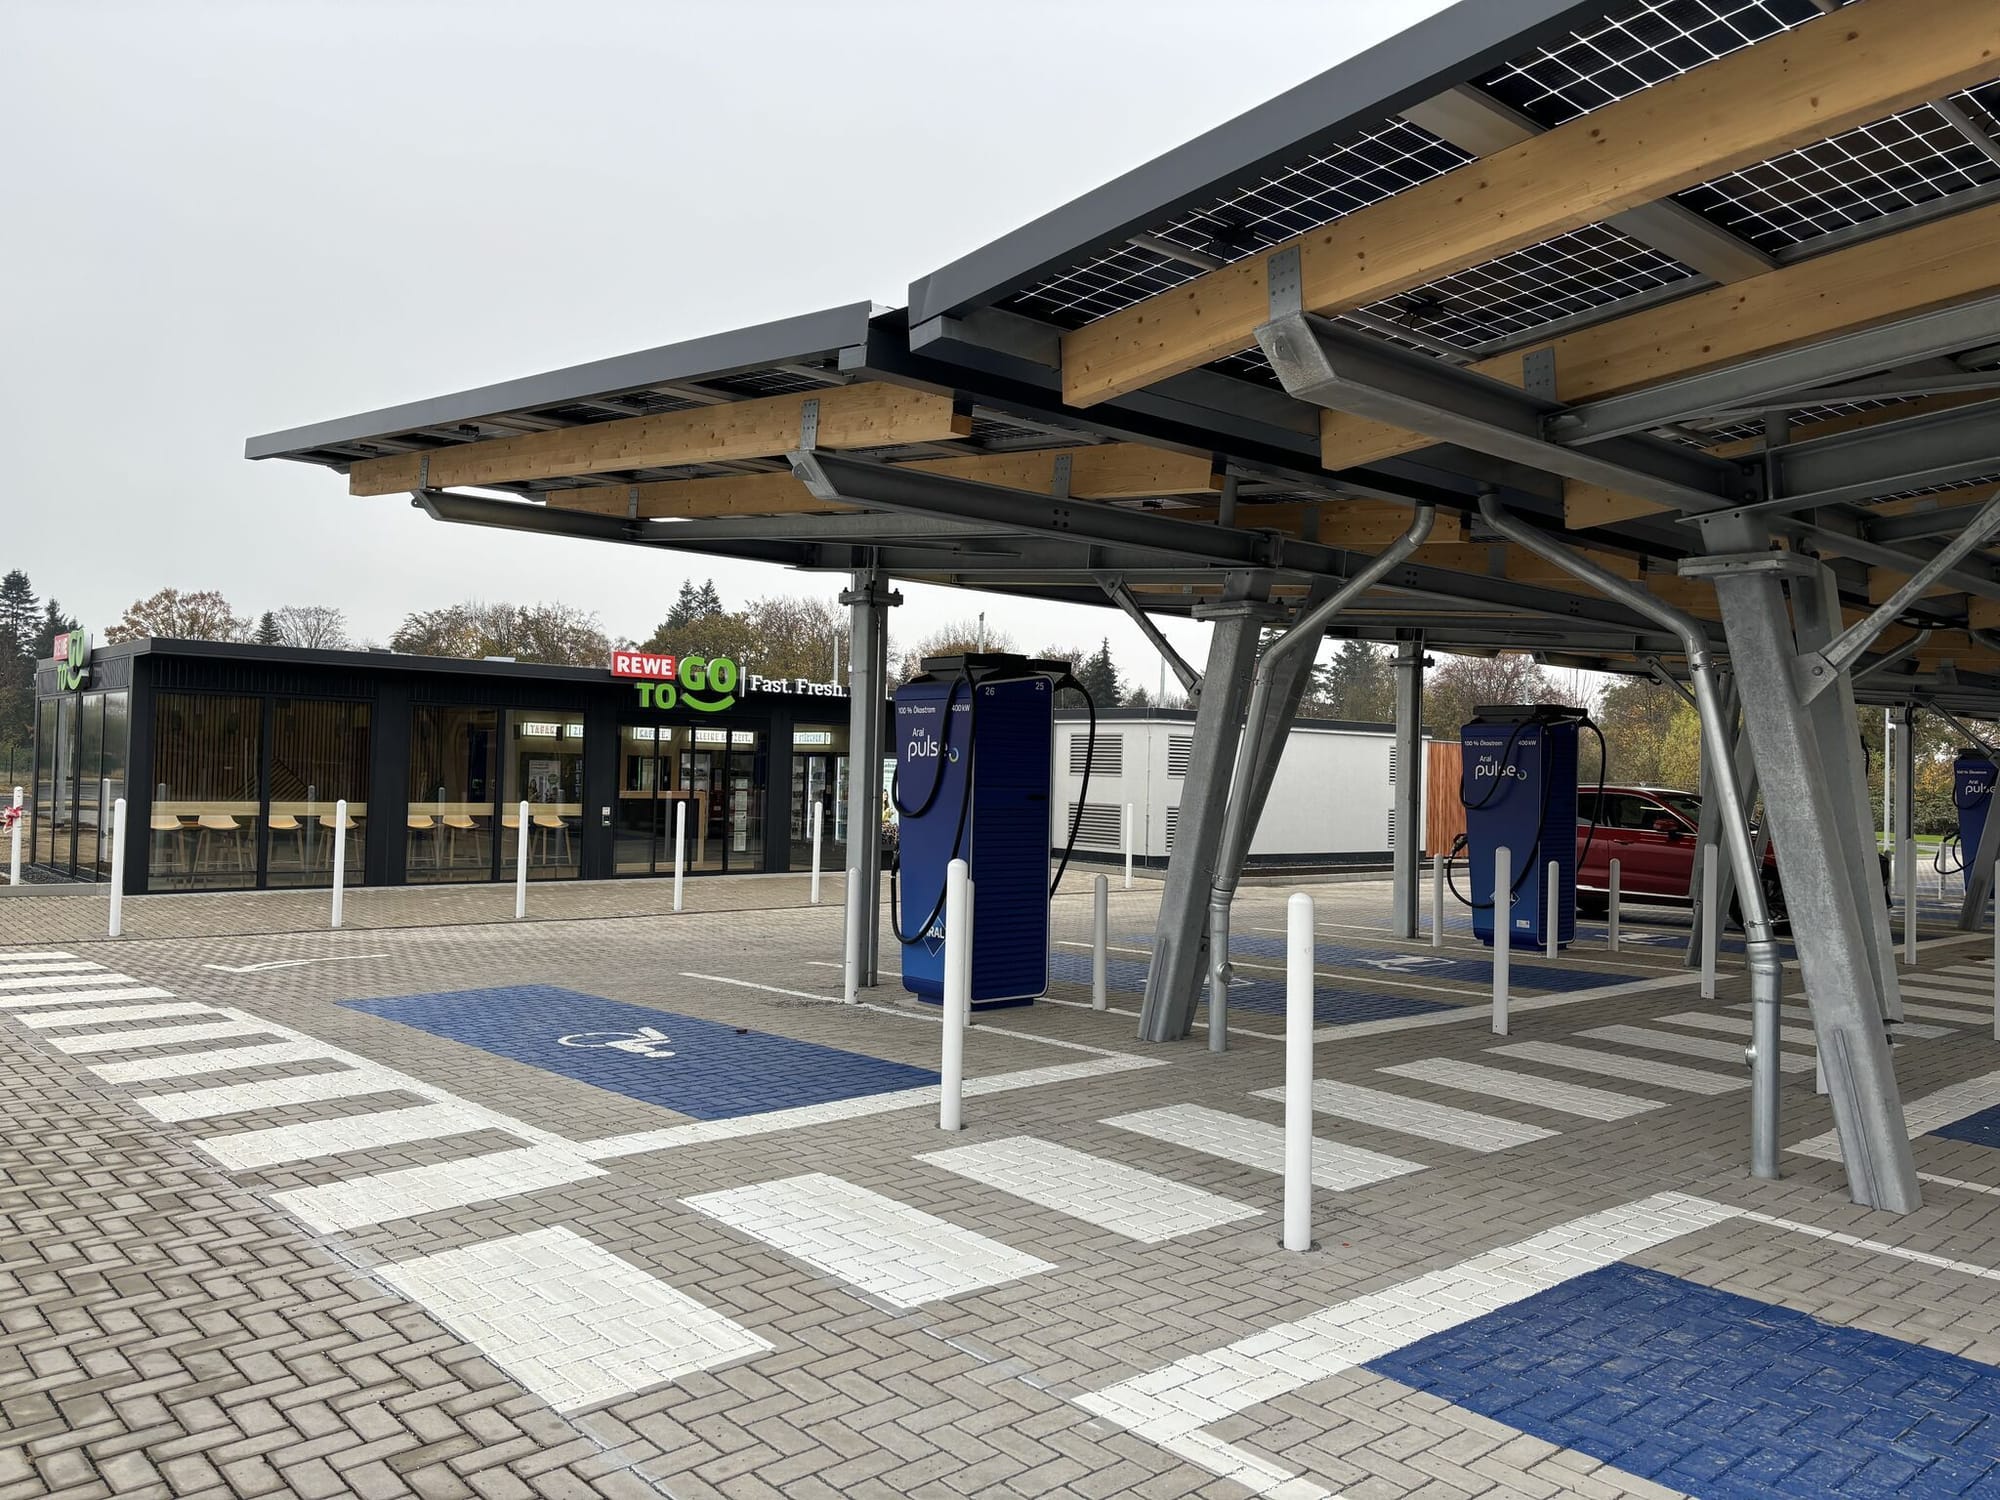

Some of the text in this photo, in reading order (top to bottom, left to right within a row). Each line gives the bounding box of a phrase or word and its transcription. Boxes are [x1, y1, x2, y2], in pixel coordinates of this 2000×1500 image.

[616, 655, 673, 676] REWE
[678, 656, 737, 693] GO
[635, 682, 677, 710] TO
[749, 674, 848, 698] Fast. Fresh.
[985, 687, 995, 696] 26
[1035, 681, 1045, 691] 25
[912, 727, 925, 737] Aral
